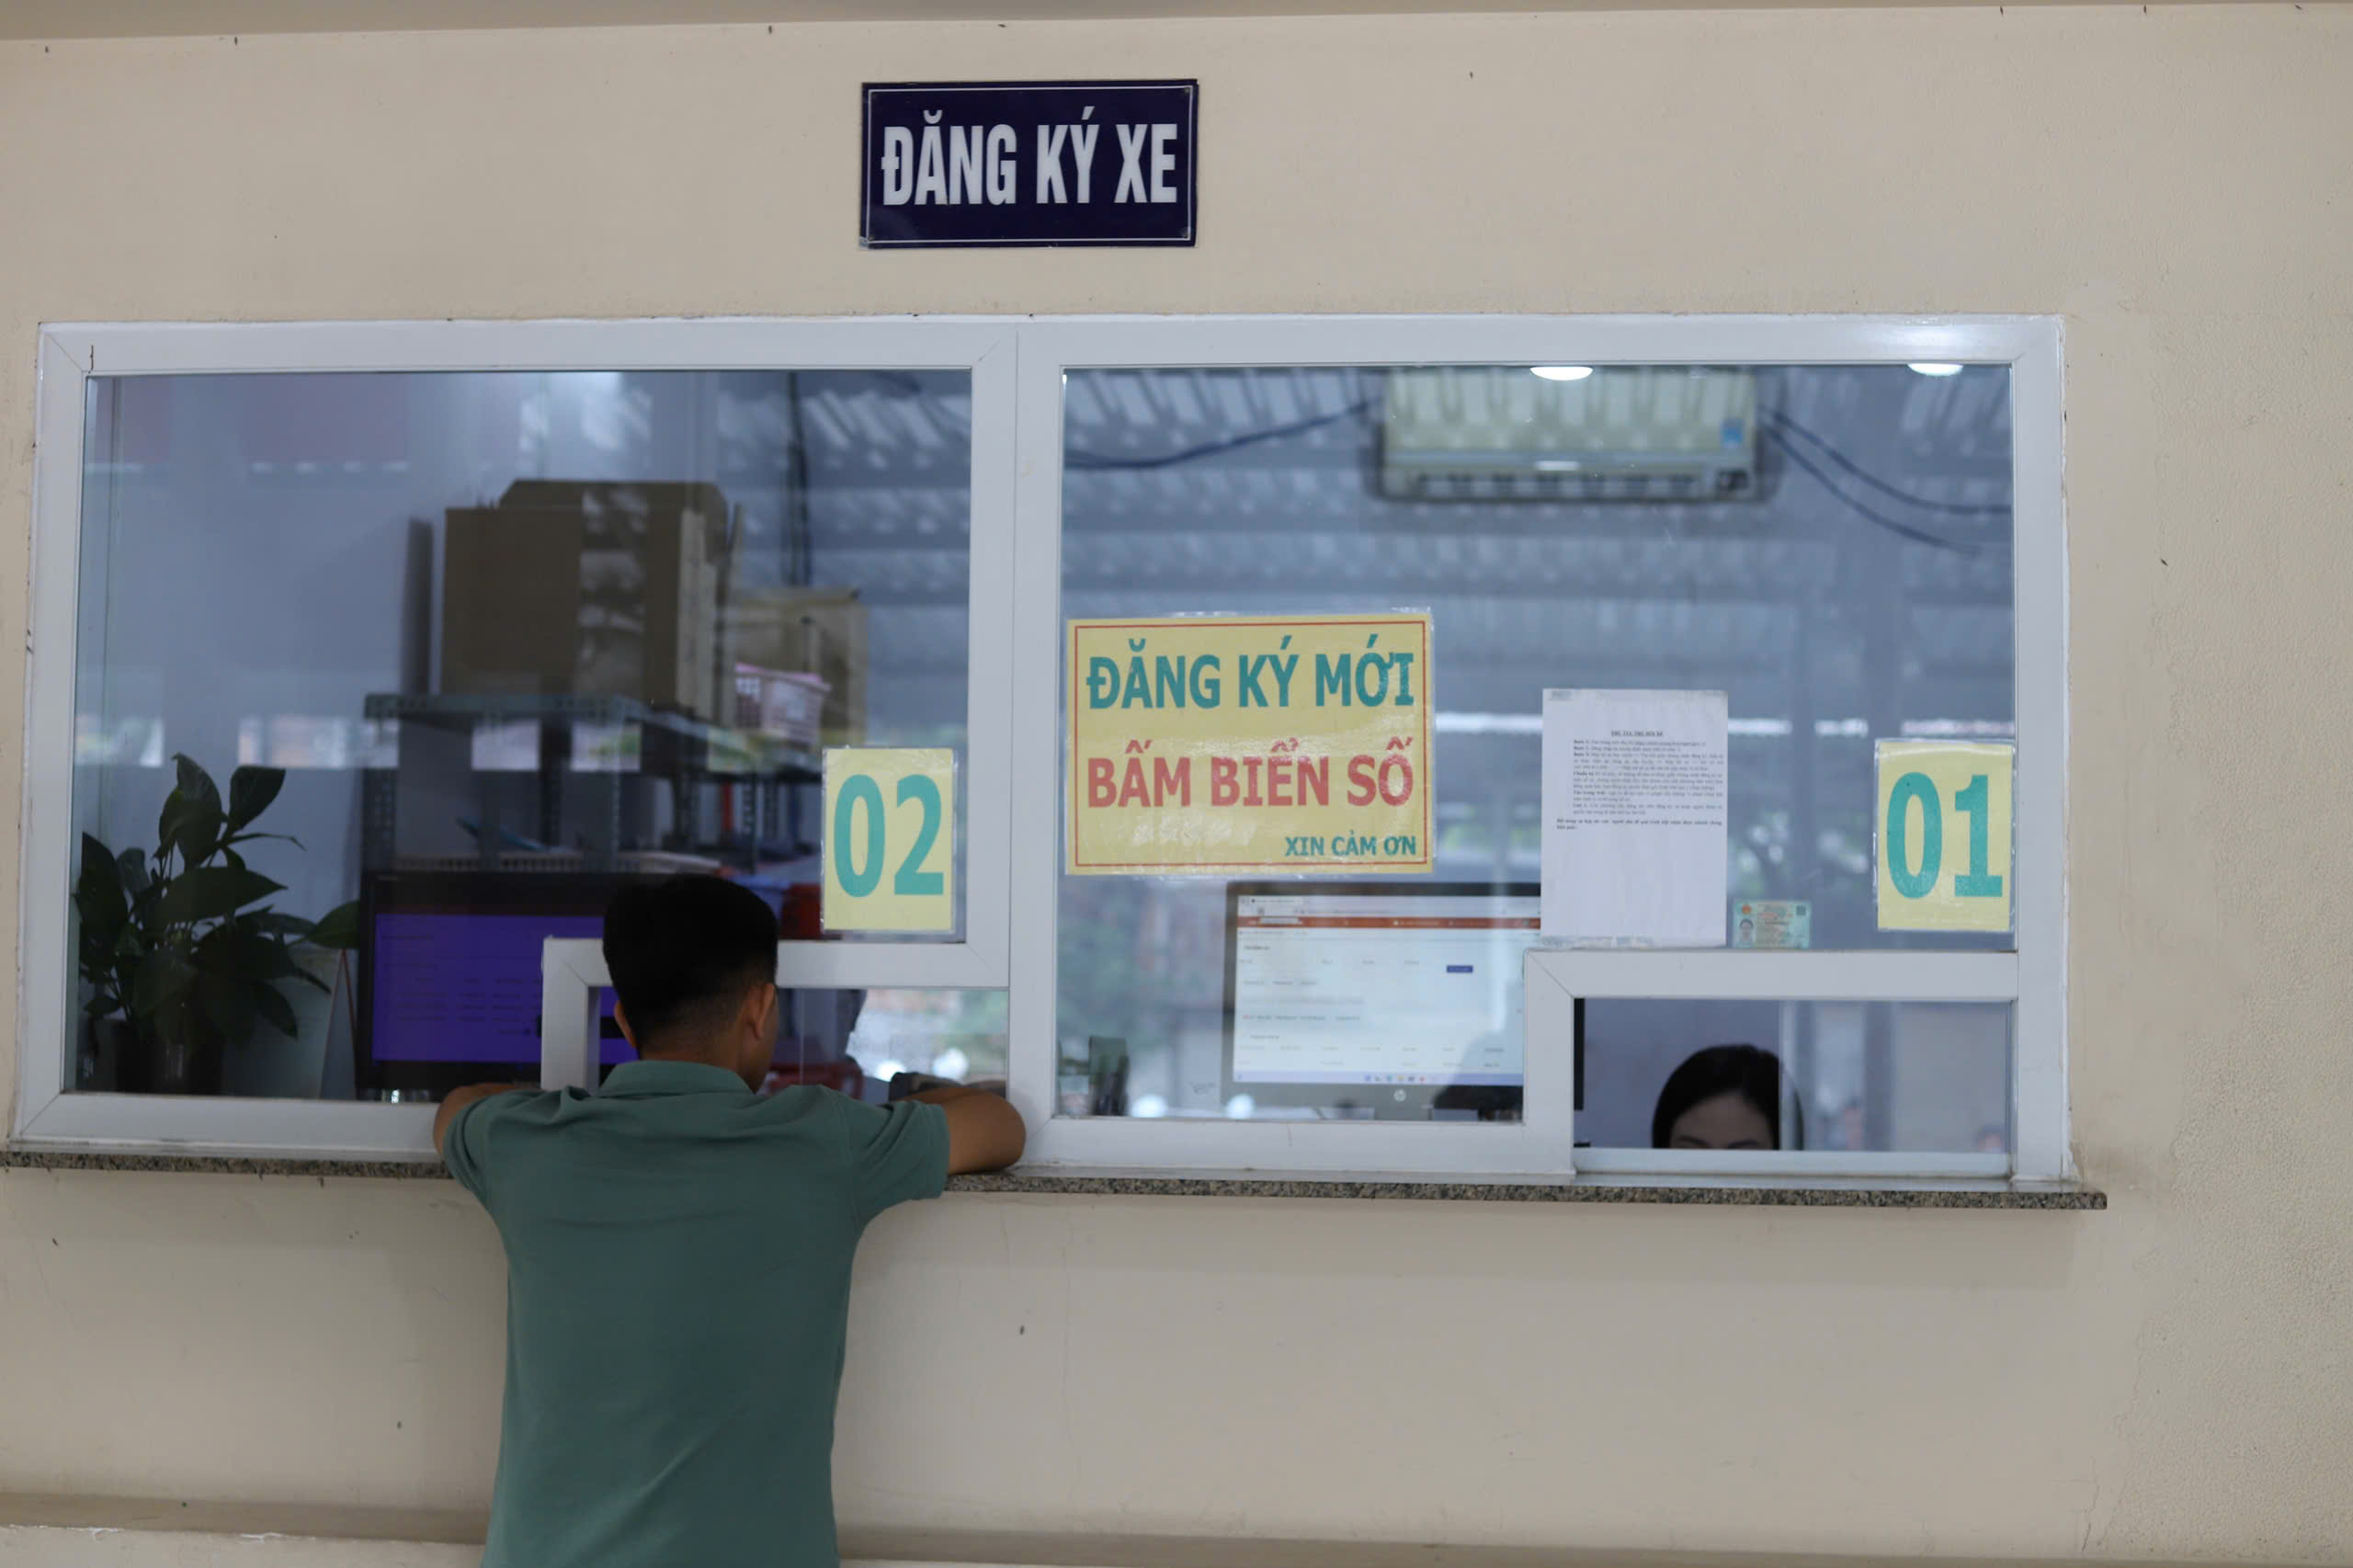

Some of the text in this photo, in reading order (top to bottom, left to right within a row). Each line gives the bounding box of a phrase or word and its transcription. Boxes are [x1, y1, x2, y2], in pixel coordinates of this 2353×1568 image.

[881, 106, 1177, 205] ĐĂNG KÝ XE
[1086, 634, 1415, 709] ĐĂNG KÝ MỚI
[1087, 736, 1414, 808] BẤM BIỂN SỐ
[834, 774, 944, 898] 02
[1284, 829, 1416, 857] XIN CẢM ƠN
[1887, 771, 2003, 899] 01
